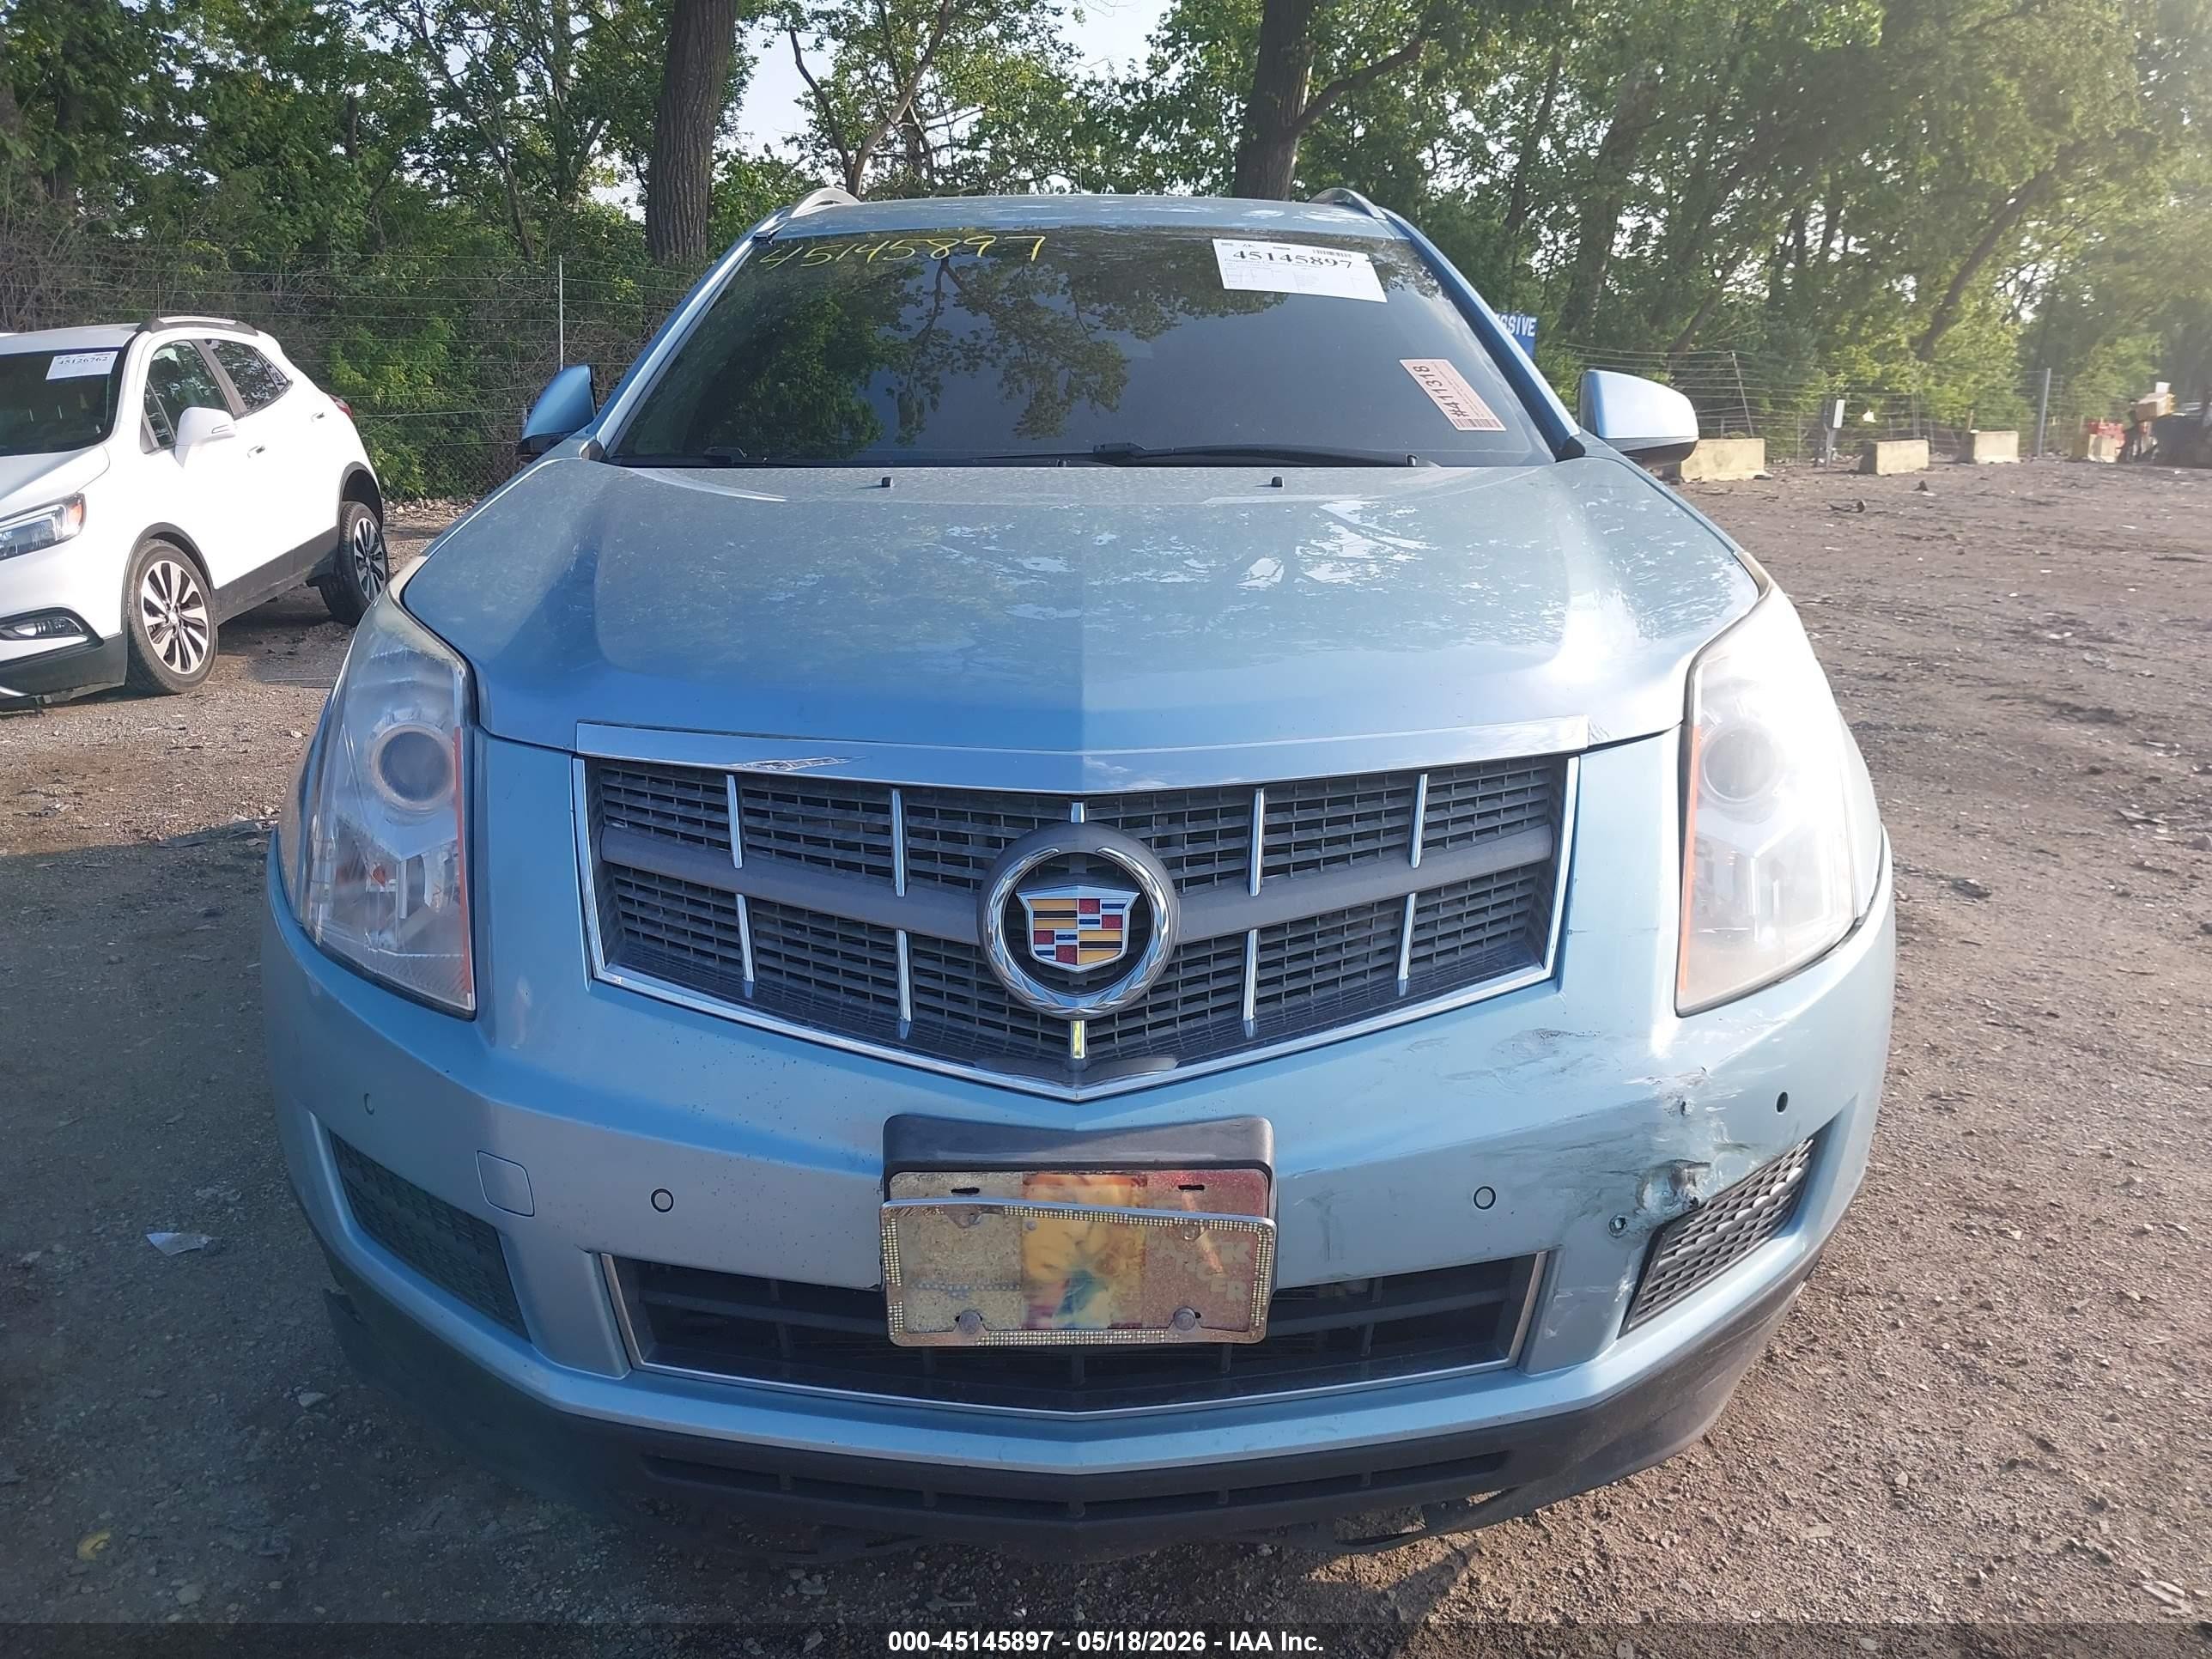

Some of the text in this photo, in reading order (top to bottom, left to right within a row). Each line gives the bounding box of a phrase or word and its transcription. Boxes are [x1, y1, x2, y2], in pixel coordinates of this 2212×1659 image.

[758, 235, 1047, 270] 45145897
[1232, 249, 1353, 270] 45145897
[1413, 365, 1470, 418] #411318
